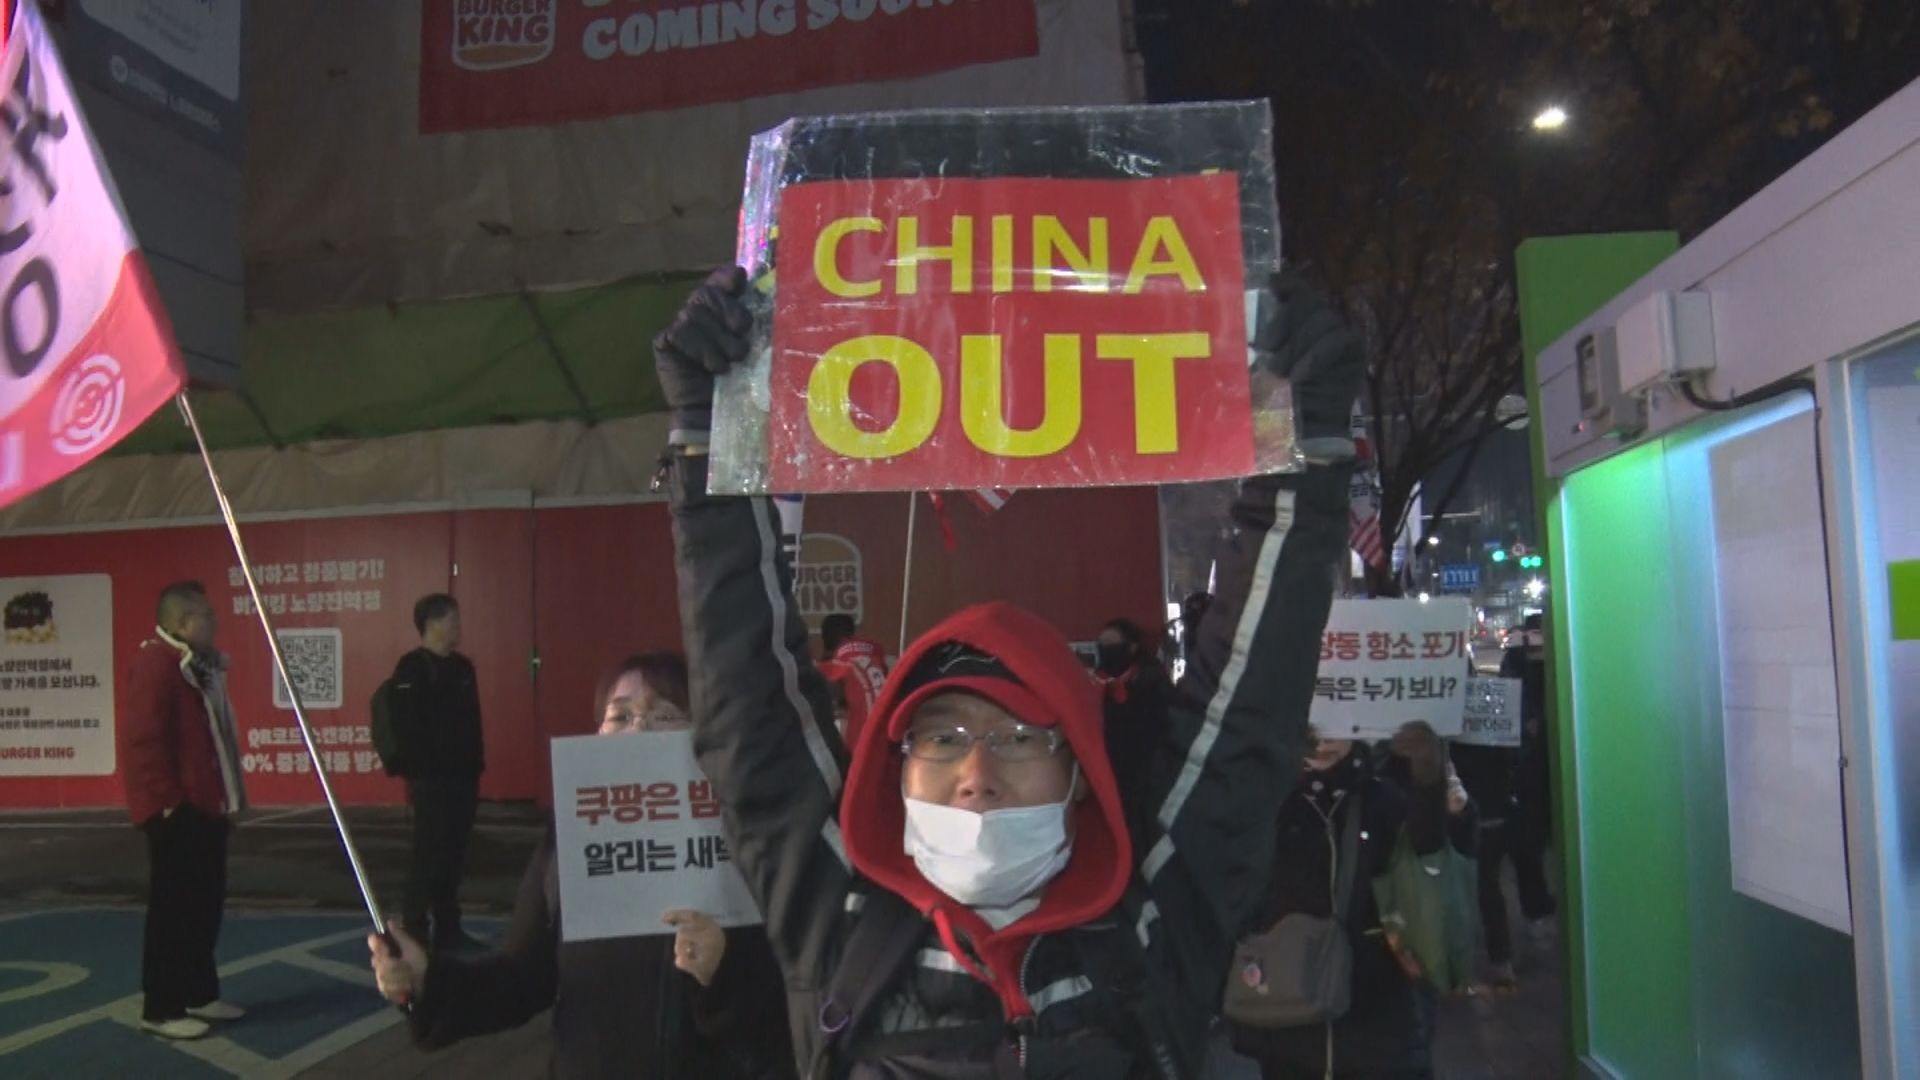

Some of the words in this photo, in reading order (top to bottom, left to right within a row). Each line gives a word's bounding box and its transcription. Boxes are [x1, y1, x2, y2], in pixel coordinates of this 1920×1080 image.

[458, 15, 550, 47] KING
[582, 0, 797, 60] COMING
[807, 0, 954, 31] SO
[813, 215, 1206, 298] CHINA
[807, 331, 1211, 459] OUT
[798, 565, 858, 585] RGER
[797, 584, 858, 612] ING
[1366, 631, 1415, 661] 항소
[1420, 631, 1465, 659] 포기
[1362, 677, 1405, 701] 누가
[1408, 676, 1457, 699] 보나?
[0, 747, 41, 760] URGER
[44, 747, 76, 760] KING
[241, 752, 274, 773] 0%
[576, 782, 681, 826] 쿠팡은
[583, 839, 677, 878] 알리는
